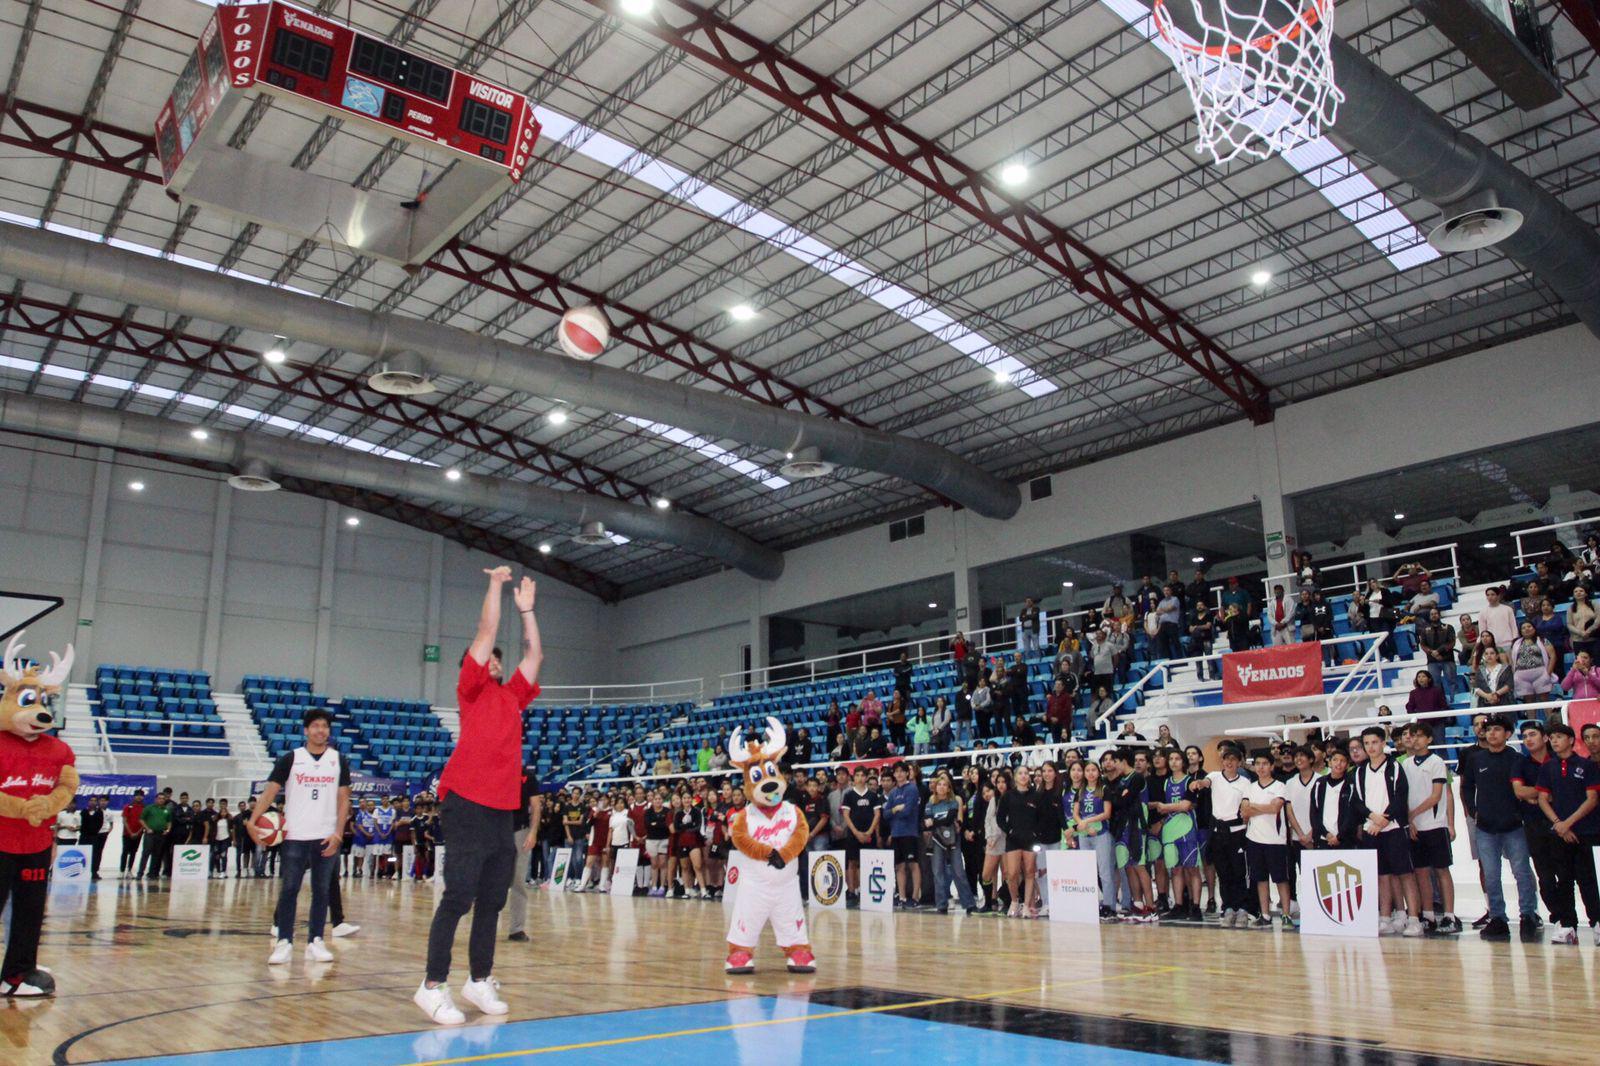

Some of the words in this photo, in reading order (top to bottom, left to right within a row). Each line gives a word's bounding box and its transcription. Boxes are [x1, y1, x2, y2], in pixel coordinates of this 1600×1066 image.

[283, 9, 334, 40] VENADOS
[233, 7, 252, 85] LOBOS
[469, 80, 514, 109] VISITOR
[407, 109, 433, 124] PERIOD
[1236, 663, 1305, 687] VENADOS
[350, 782, 392, 792] nis.mx
[21, 868, 47, 881] 911
[1061, 885, 1096, 893] TECMILENIO
